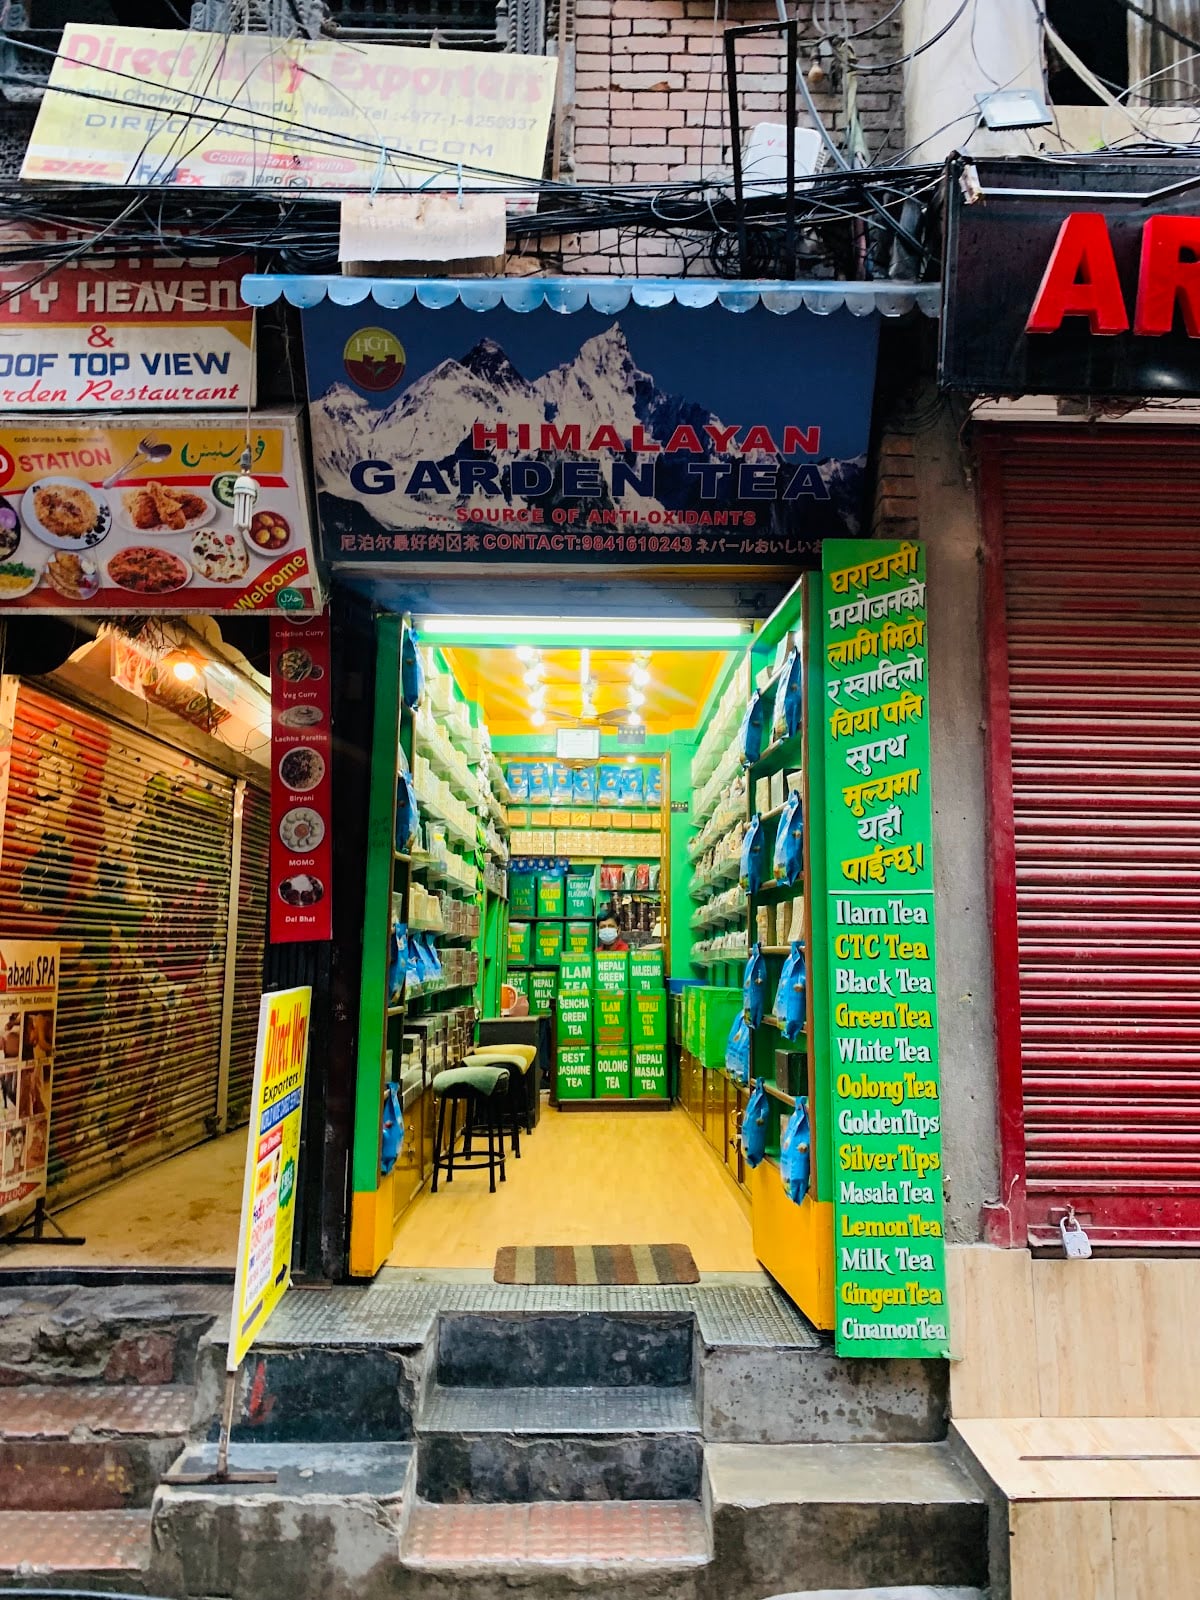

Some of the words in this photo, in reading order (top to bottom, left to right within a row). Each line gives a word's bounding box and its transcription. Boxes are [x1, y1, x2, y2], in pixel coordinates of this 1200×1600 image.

[61, 34, 196, 77] Direct
[331, 53, 543, 103] Exporters
[40, 158, 110, 178] DHL
[77, 280, 239, 313] HEAVEN
[88, 325, 115, 348] &
[68, 353, 130, 377] TOP
[141, 351, 230, 376] VIEW
[77, 380, 239, 402] Restaurant
[472, 423, 821, 455] HIMALAYAN
[19, 448, 112, 472] STATION
[349, 459, 656, 498] GARDEN
[688, 461, 831, 500] TEA
[456, 508, 545, 524] SOURCE
[551, 509, 579, 524] OF
[588, 509, 757, 526] ANTI-OXIDANTS
[483, 533, 692, 553] CONTACT:9841610243
[830, 541, 919, 594] घरायसी
[234, 554, 306, 609] Welcome
[827, 628, 880, 670] लागि
[881, 616, 925, 656] मिठो
[283, 692, 297, 700] Veg
[828, 679, 842, 706] र
[830, 706, 880, 740] चिया
[846, 734, 908, 776] सुपथ
[836, 900, 888, 925] Ilam
[888, 899, 929, 925] Tea
[835, 934, 880, 960] CTC
[884, 933, 929, 960] Tea
[36, 955, 56, 984] SPA
[562, 966, 591, 979] ILAM
[598, 962, 625, 971] NEPALI
[598, 972, 624, 982] GREEN
[533, 978, 554, 988] NEPALI
[534, 989, 552, 998] MILK
[835, 968, 896, 997] Black
[896, 968, 934, 994] Tea
[560, 999, 589, 1009] SENCHA
[835, 1003, 896, 1029] Green
[895, 1003, 933, 1028] Tea
[562, 1012, 587, 1022] GREEN
[604, 1014, 619, 1025] TEA
[568, 1025, 582, 1035] TEA
[562, 1053, 585, 1063] BEST
[636, 1054, 662, 1064] NEPALI
[836, 1037, 893, 1063] White
[895, 1037, 931, 1062] Tea
[558, 1066, 591, 1075] JASMINE
[598, 1061, 628, 1072] OOLONG
[634, 1067, 664, 1077] MASALA
[263, 1071, 298, 1104] Exporters
[566, 1078, 583, 1088] TEA
[606, 1077, 620, 1088] TEA
[641, 1080, 656, 1090] TEA
[836, 1073, 904, 1105] Oolong
[904, 1072, 939, 1099] Tea
[838, 1109, 903, 1135] Golden
[902, 1109, 941, 1139] Tips
[839, 1144, 898, 1172] Silver
[897, 1144, 941, 1178] Tips
[840, 1181, 899, 1205] Masala
[899, 1181, 935, 1204] Tea
[841, 1215, 909, 1238] Lemon
[908, 1214, 943, 1238] Tea
[841, 1248, 896, 1275] Milk
[895, 1247, 935, 1272] Tea
[916, 1317, 947, 1340] Tea
